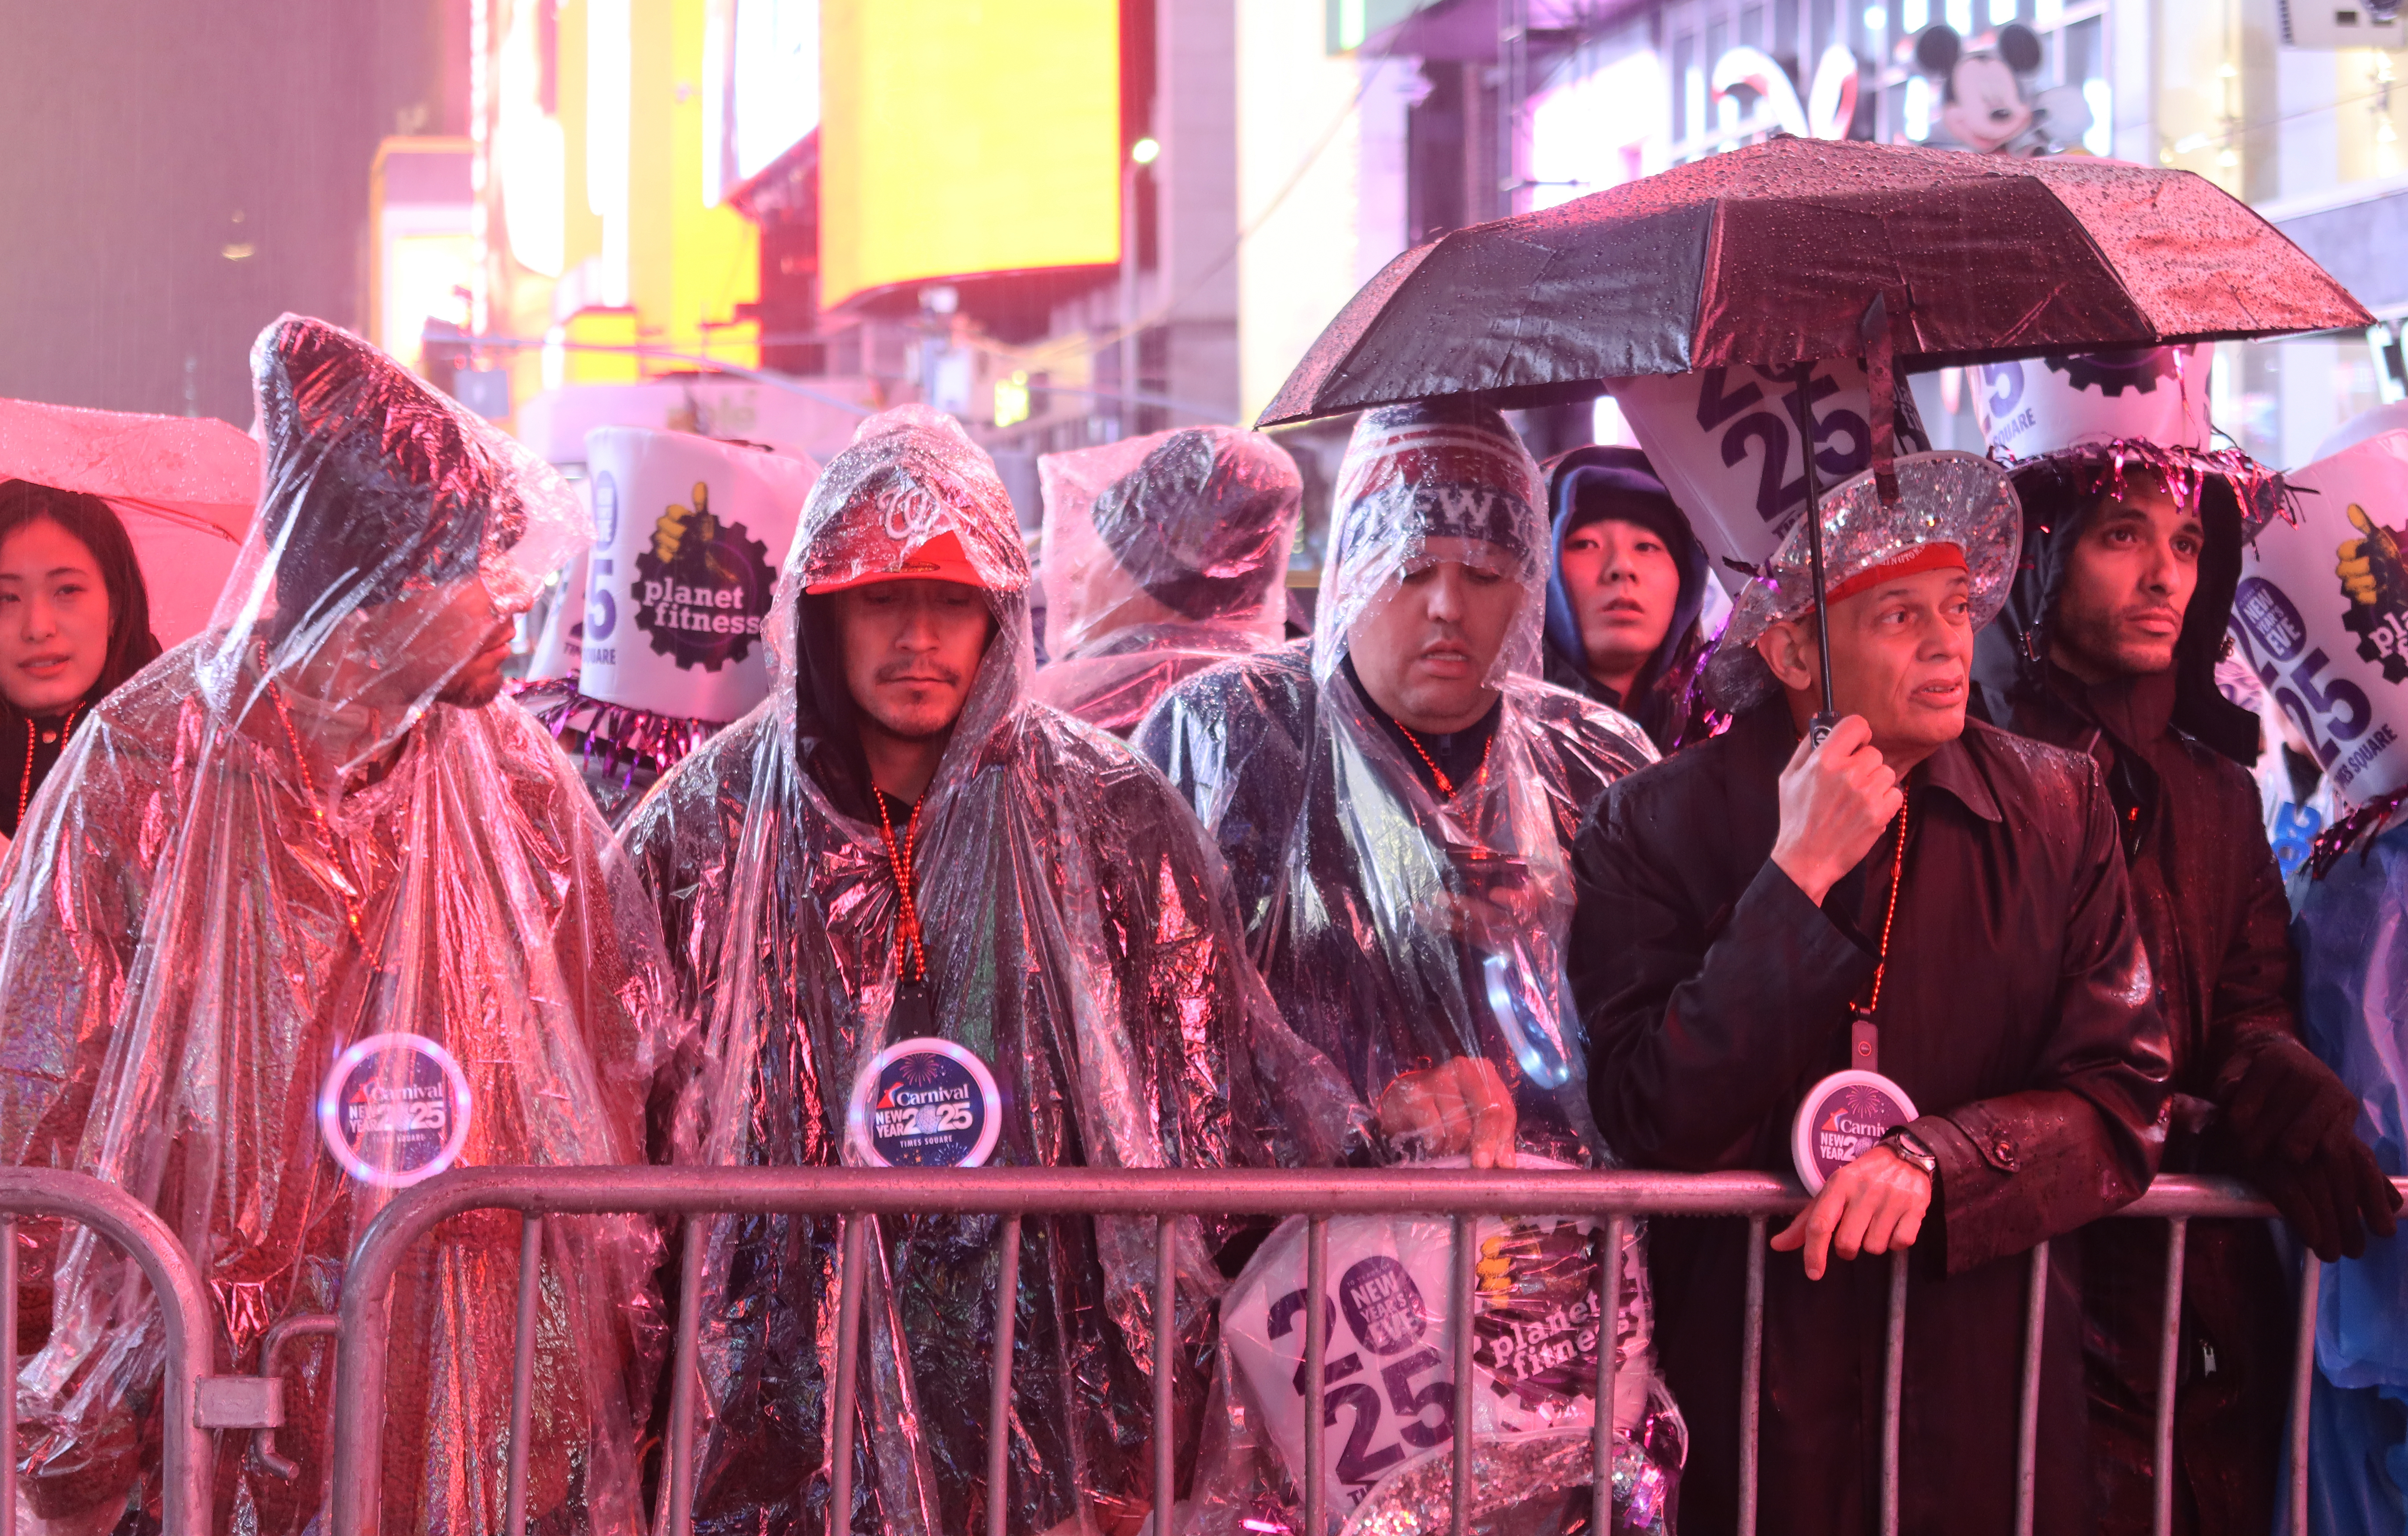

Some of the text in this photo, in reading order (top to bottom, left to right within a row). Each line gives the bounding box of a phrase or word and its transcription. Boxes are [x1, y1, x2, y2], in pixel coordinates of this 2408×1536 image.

[876, 486, 941, 541] W
[642, 576, 744, 609] planet
[2243, 589, 2275, 625] NEW
[654, 601, 761, 635] fitness
[2266, 617, 2301, 656] EVE
[2348, 722, 2398, 774] SQUARE
[897, 1083, 969, 1106] Carnival
[875, 1108, 903, 1125] NEW
[876, 1123, 904, 1139] YEAR
[1840, 1119, 1889, 1138] Carniv
[900, 1134, 953, 1148] TIMES SQUARE
[1821, 1132, 1845, 1147] NEW
[1821, 1145, 1844, 1161] YEAR
[1350, 1270, 1399, 1309] NEW
[1490, 1288, 1600, 1369] planet
[1322, 1347, 1454, 1485] 25
